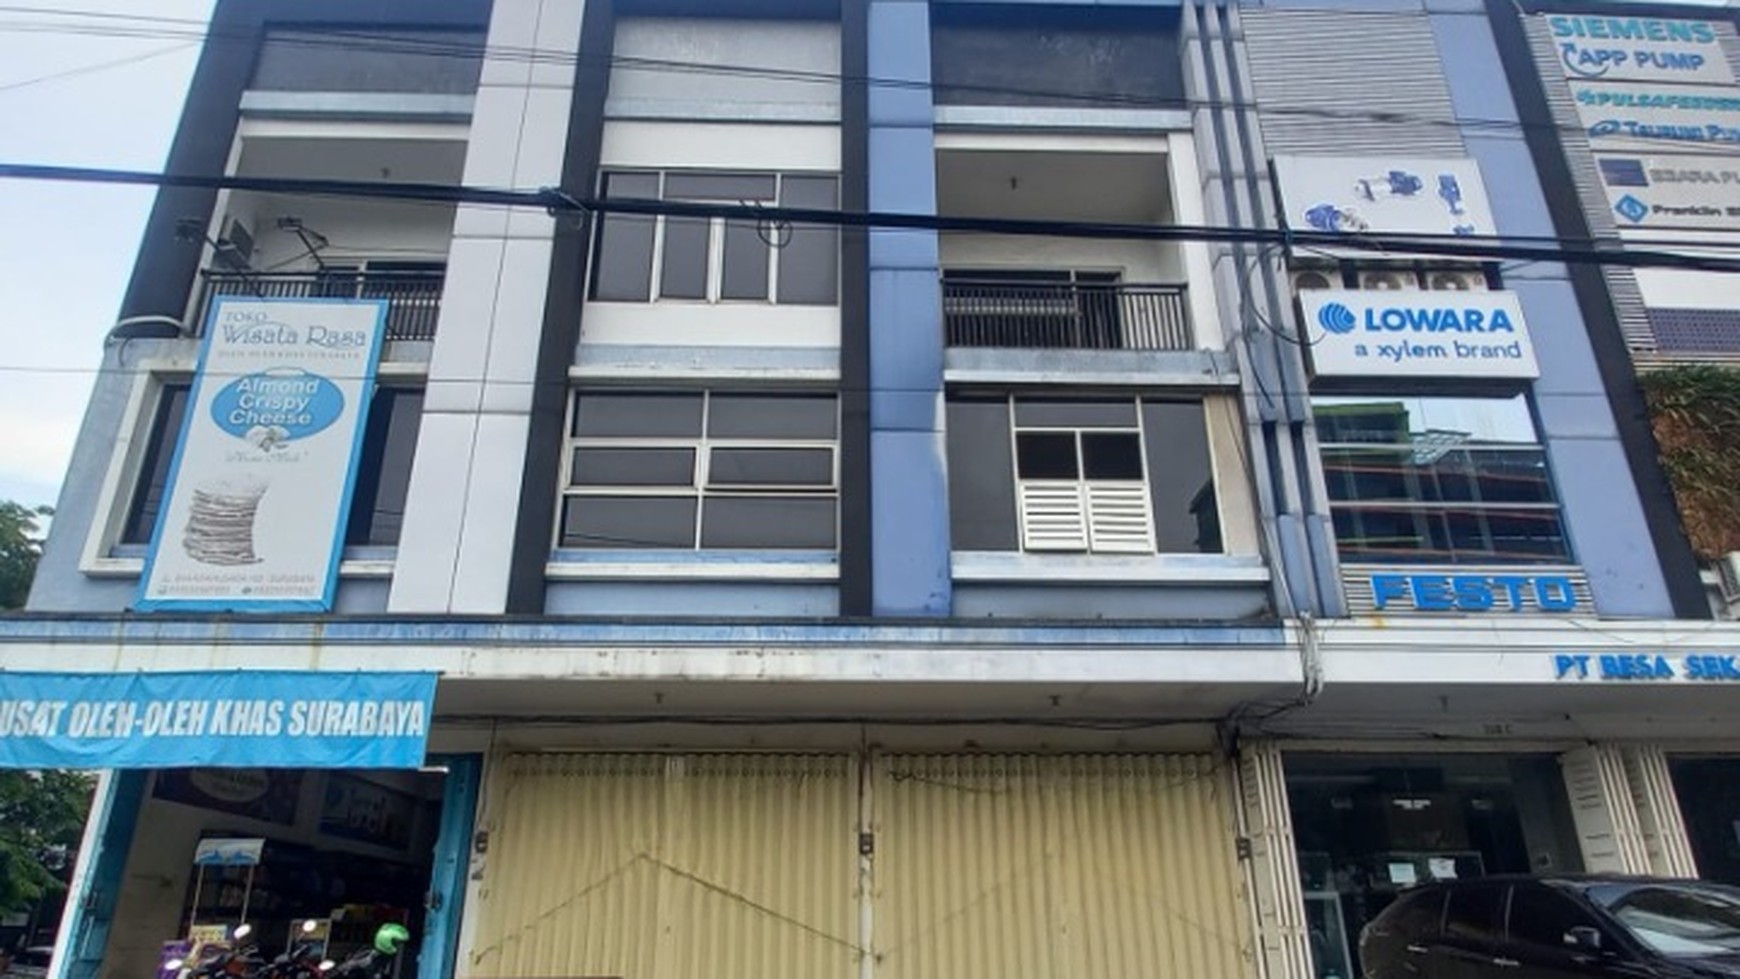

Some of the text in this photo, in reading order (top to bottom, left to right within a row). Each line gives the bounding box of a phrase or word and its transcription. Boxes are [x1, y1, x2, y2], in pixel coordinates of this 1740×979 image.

[1550, 16, 1716, 43] SIEMENS
[1578, 49, 1706, 70] APP PUMP
[1365, 308, 1515, 332] LOWARA
[223, 322, 366, 348] Wisata Rasa
[1355, 340, 1523, 362] a xylem brand
[236, 379, 319, 394] Almond
[239, 393, 312, 414] Crispy
[229, 409, 312, 424] Cheese
[1370, 574, 1578, 612] FESTO
[1554, 655, 1592, 679] PT
[1600, 654, 1676, 680] BESA
[68, 700, 209, 738] OLEH-OLEH
[210, 700, 284, 737] KHAS
[288, 700, 425, 737] SURABAYA
